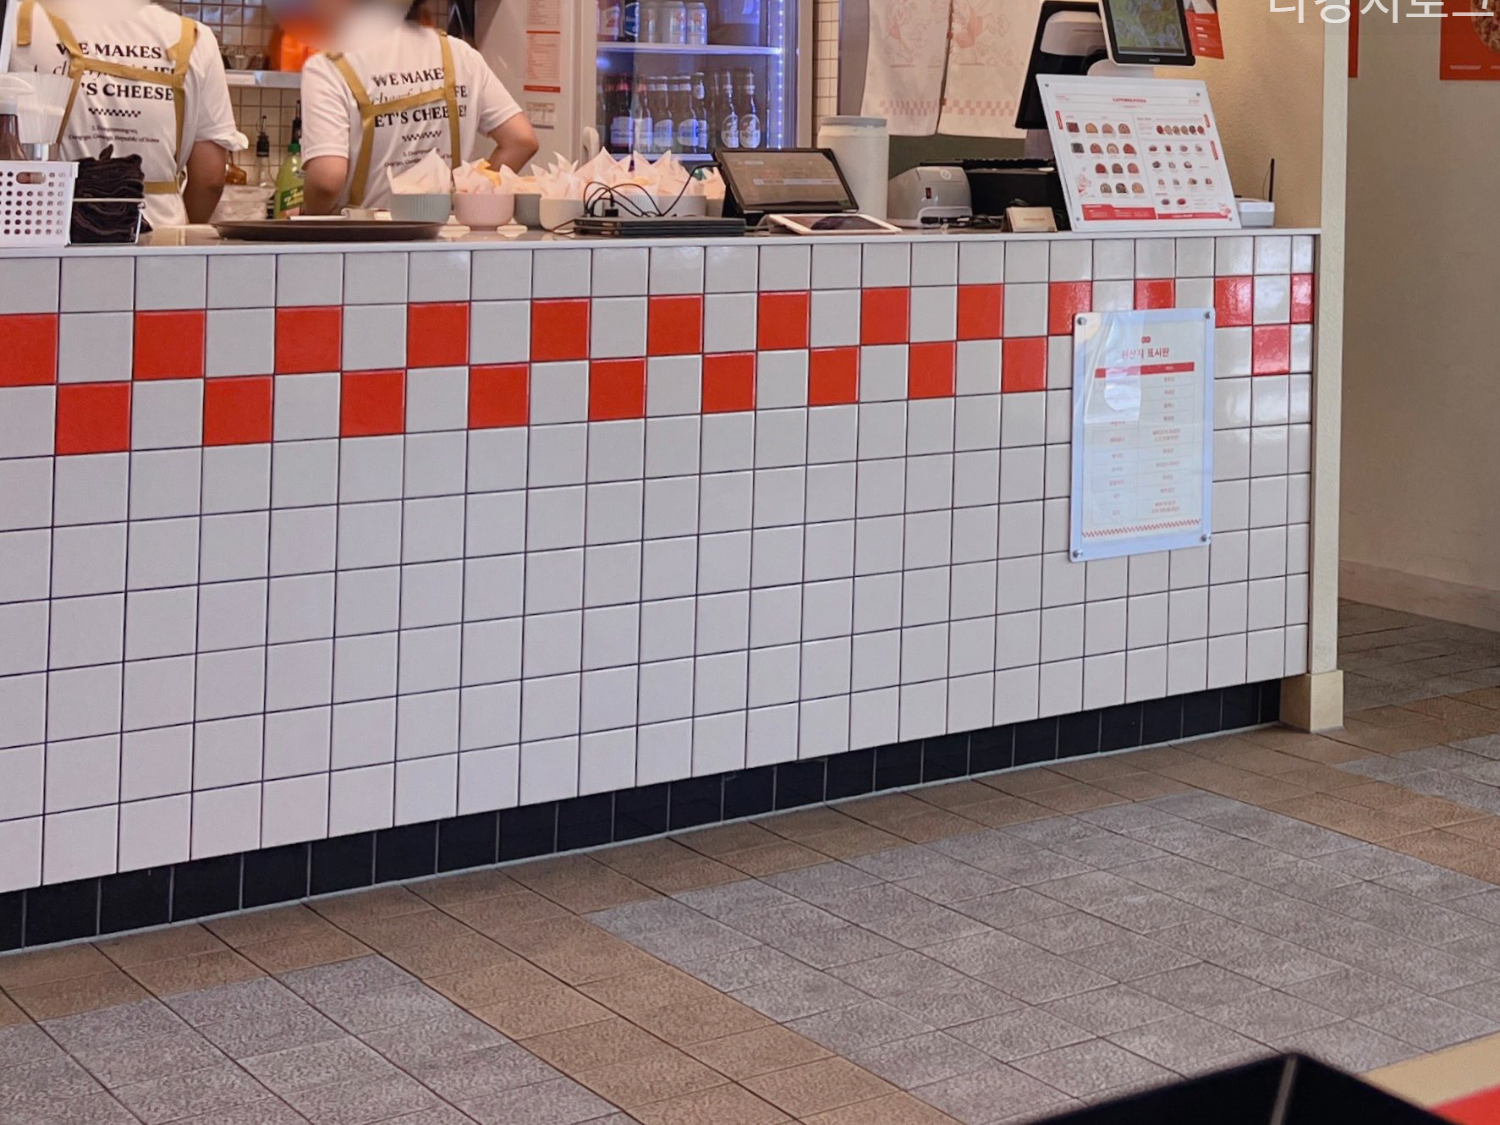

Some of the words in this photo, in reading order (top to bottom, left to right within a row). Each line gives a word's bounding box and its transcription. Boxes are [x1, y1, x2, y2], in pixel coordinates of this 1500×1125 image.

[95, 43, 162, 59] MAKES
[372, 73, 399, 87] WE
[374, 111, 409, 128] ET'S
